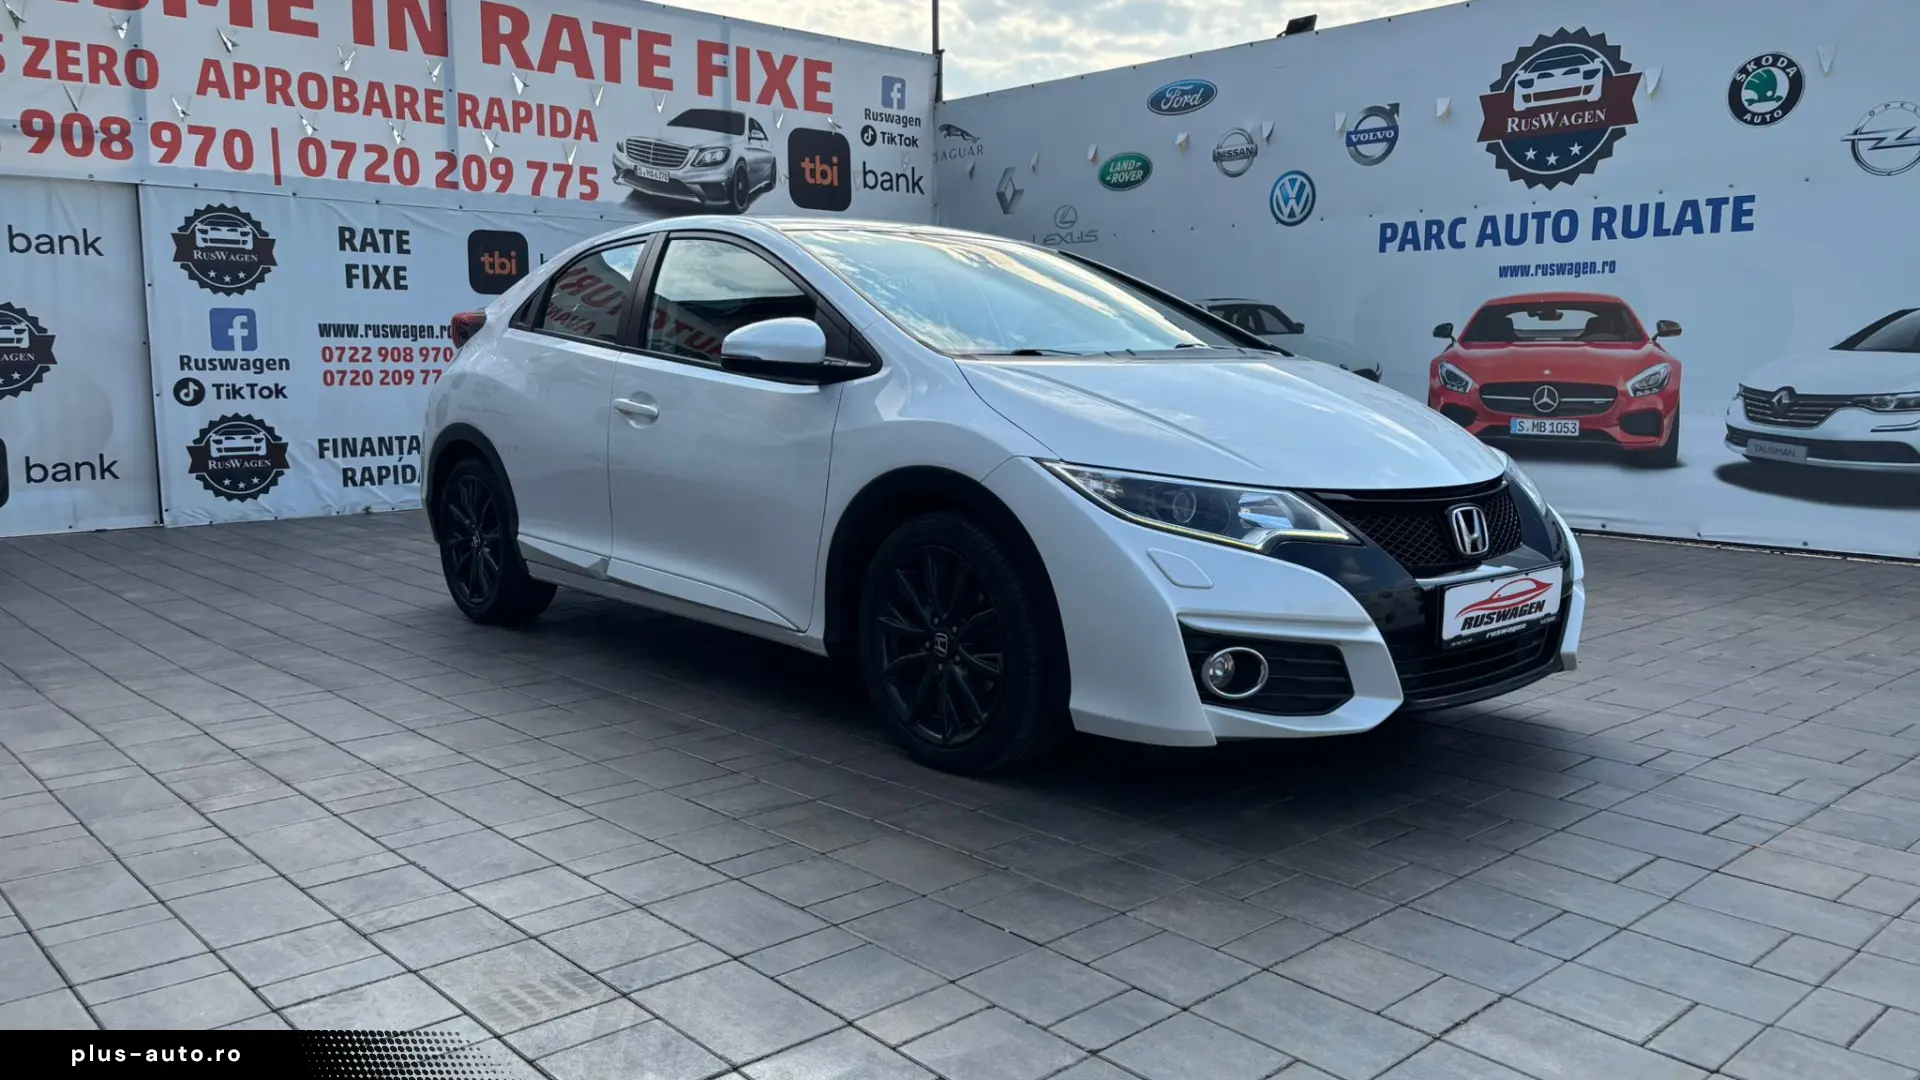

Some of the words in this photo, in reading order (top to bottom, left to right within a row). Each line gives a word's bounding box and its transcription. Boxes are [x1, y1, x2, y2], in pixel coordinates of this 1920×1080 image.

[480, 0, 674, 92] RATE
[697, 39, 833, 114] FIXE
[22, 36, 159, 90] ZERO
[196, 58, 446, 125] APROBARE
[457, 92, 598, 143] RAPIDA
[1161, 85, 1204, 110] Ford
[864, 108, 922, 128] Ruswagen
[1743, 109, 1782, 123] AUTO
[880, 131, 919, 148] TikTok
[1350, 129, 1395, 142] VOLVO
[20, 109, 134, 160] 908
[150, 121, 254, 170] 970
[298, 137, 420, 186] 0720
[435, 151, 514, 193] 209
[526, 160, 599, 201] 775
[932, 144, 984, 164] JAGUAR
[1216, 147, 1253, 159] NISSAN
[800, 155, 839, 187] tbi
[1110, 160, 1136, 173] LAND
[1111, 170, 1143, 184] ROVER
[862, 160, 925, 195] bank
[1378, 217, 1467, 253] PARC
[1475, 208, 1579, 248] AUTO
[1591, 195, 1756, 241] RULATE
[7, 224, 104, 257] bank
[338, 226, 411, 255] RATE
[480, 250, 517, 275] tbi
[1499, 260, 1617, 278] www.ruswagen.ro
[345, 263, 408, 291] FIXE
[1, 352, 35, 361] AGEN
[179, 355, 291, 375] Ruswagen
[321, 346, 373, 363] 0722
[378, 346, 414, 363] 908
[419, 346, 454, 363] 970
[323, 369, 374, 386] 0720
[379, 369, 415, 386] 209
[420, 369, 442, 385] 77
[211, 383, 288, 400] TikTok
[1549, 422, 1577, 434] 1053
[318, 435, 420, 462] FINANȚA
[25, 453, 120, 484] bank
[342, 464, 420, 487] RAPID
[1461, 600, 1546, 631] RUSWAGEN
